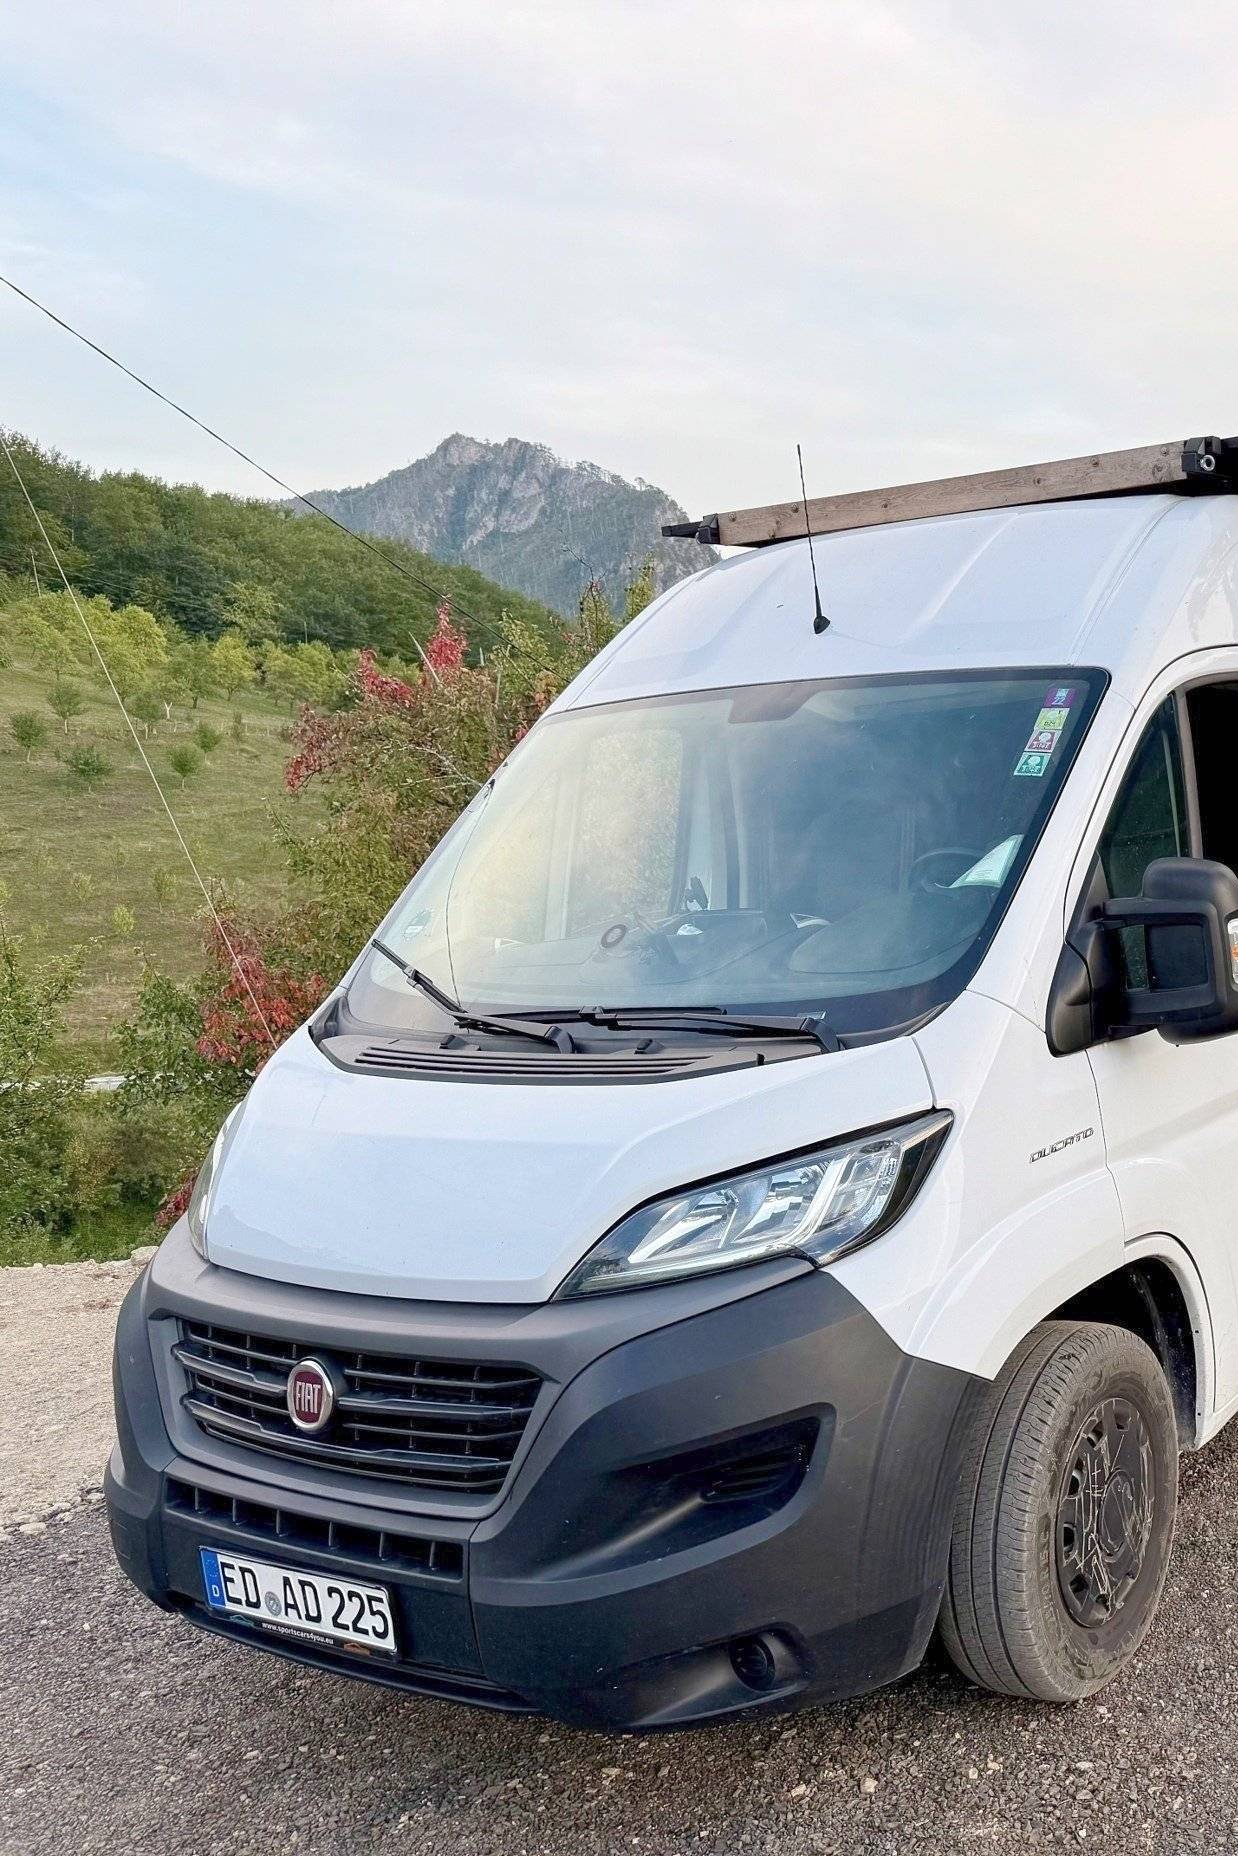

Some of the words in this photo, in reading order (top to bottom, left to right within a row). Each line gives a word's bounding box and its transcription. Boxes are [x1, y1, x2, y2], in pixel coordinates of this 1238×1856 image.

[1029, 1127, 1094, 1164] DUCATO
[296, 1381, 321, 1413] FIAT
[212, 1585, 220, 1597] D
[219, 1561, 261, 1609] ED
[282, 1576, 322, 1623] AD
[327, 1586, 389, 1639] 225
[261, 1622, 334, 1645] www.sportscars4you.eu
